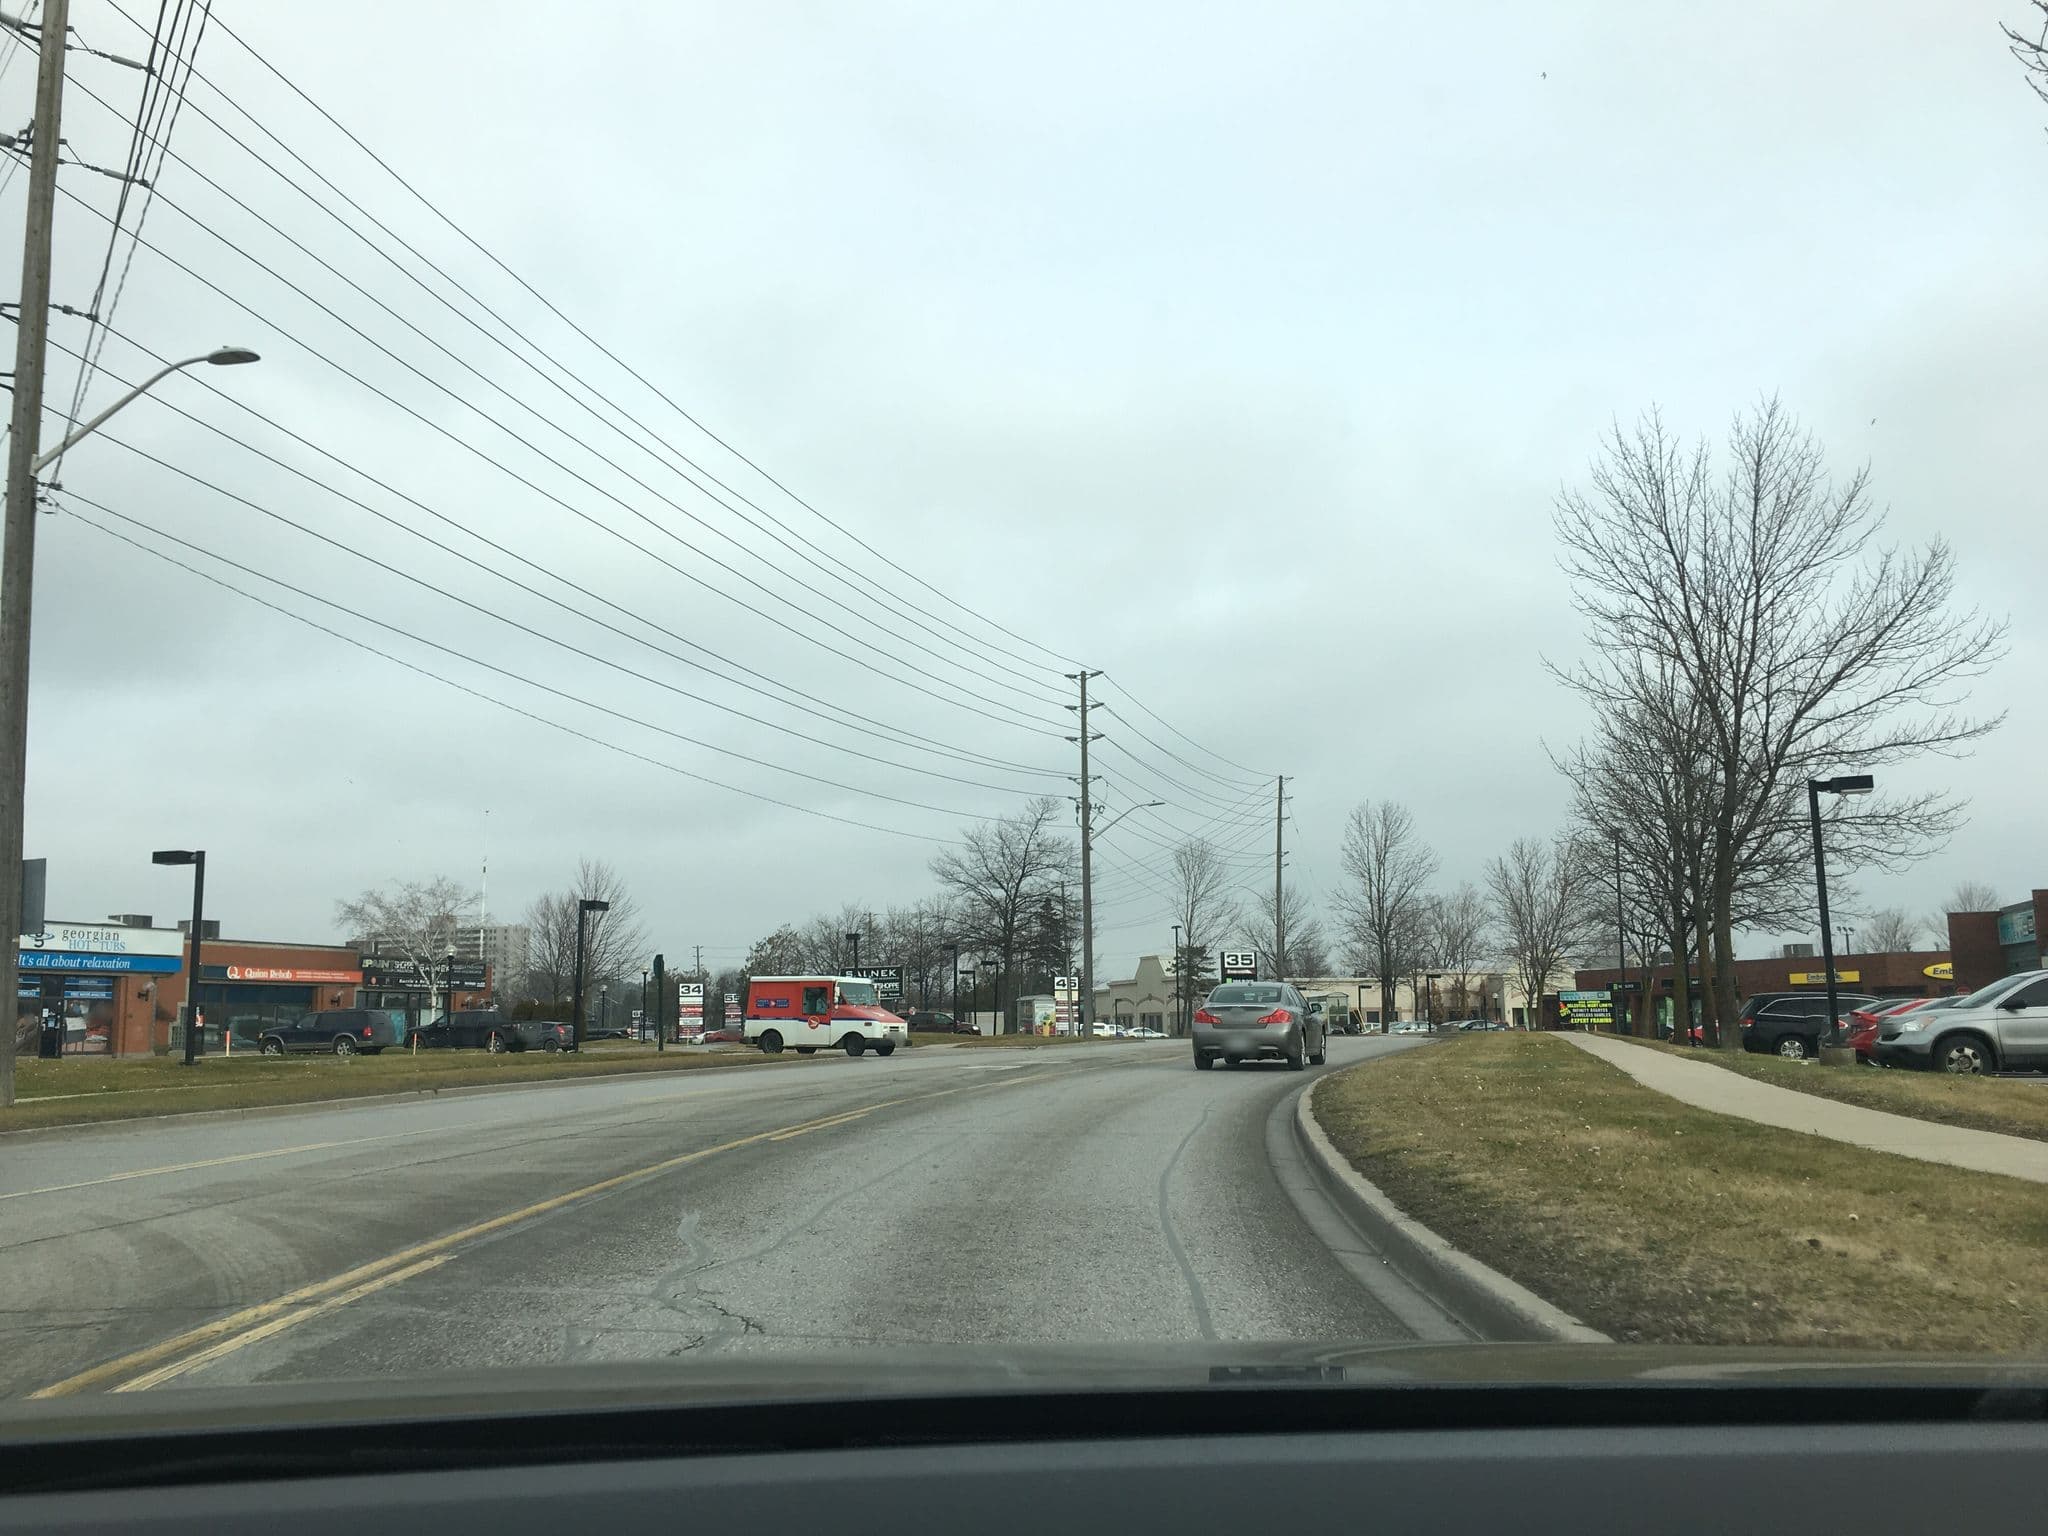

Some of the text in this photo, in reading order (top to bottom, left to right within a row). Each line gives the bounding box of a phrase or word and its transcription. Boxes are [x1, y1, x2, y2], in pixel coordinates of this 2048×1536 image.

[62, 928, 120, 942] georgian
[69, 939, 126, 952] HOT TUBS
[18, 954, 131, 969] It's all about relaxation
[1226, 954, 1253, 966] 35
[681, 985, 702, 994] 34
[1056, 979, 1077, 988] 45
